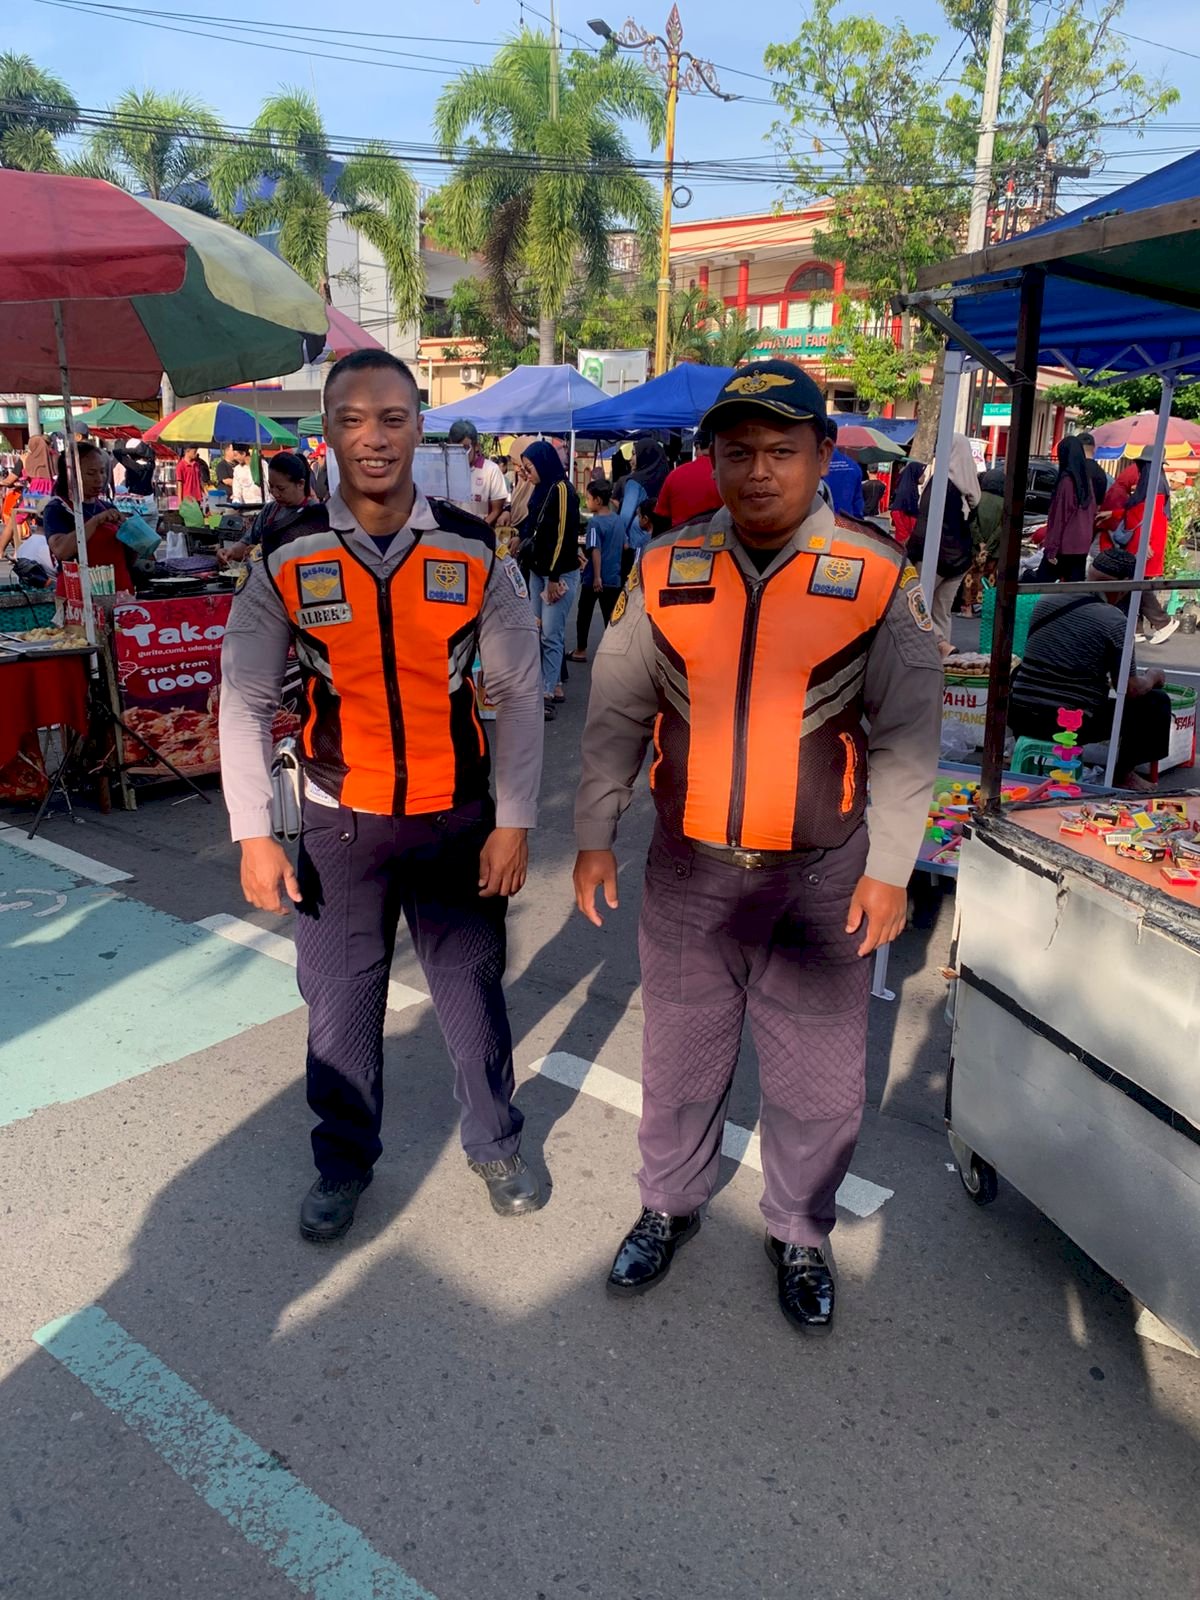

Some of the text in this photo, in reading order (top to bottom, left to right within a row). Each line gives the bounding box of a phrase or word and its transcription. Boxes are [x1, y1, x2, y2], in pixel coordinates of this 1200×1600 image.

[675, 550, 712, 561] DISHUB
[302, 566, 338, 579] DISHUB
[428, 590, 465, 602] DISHUB
[813, 583, 854, 597] DISHUB
[140, 659, 209, 676] Start from
[148, 671, 213, 693] 1000
[943, 691, 977, 709] AHU
